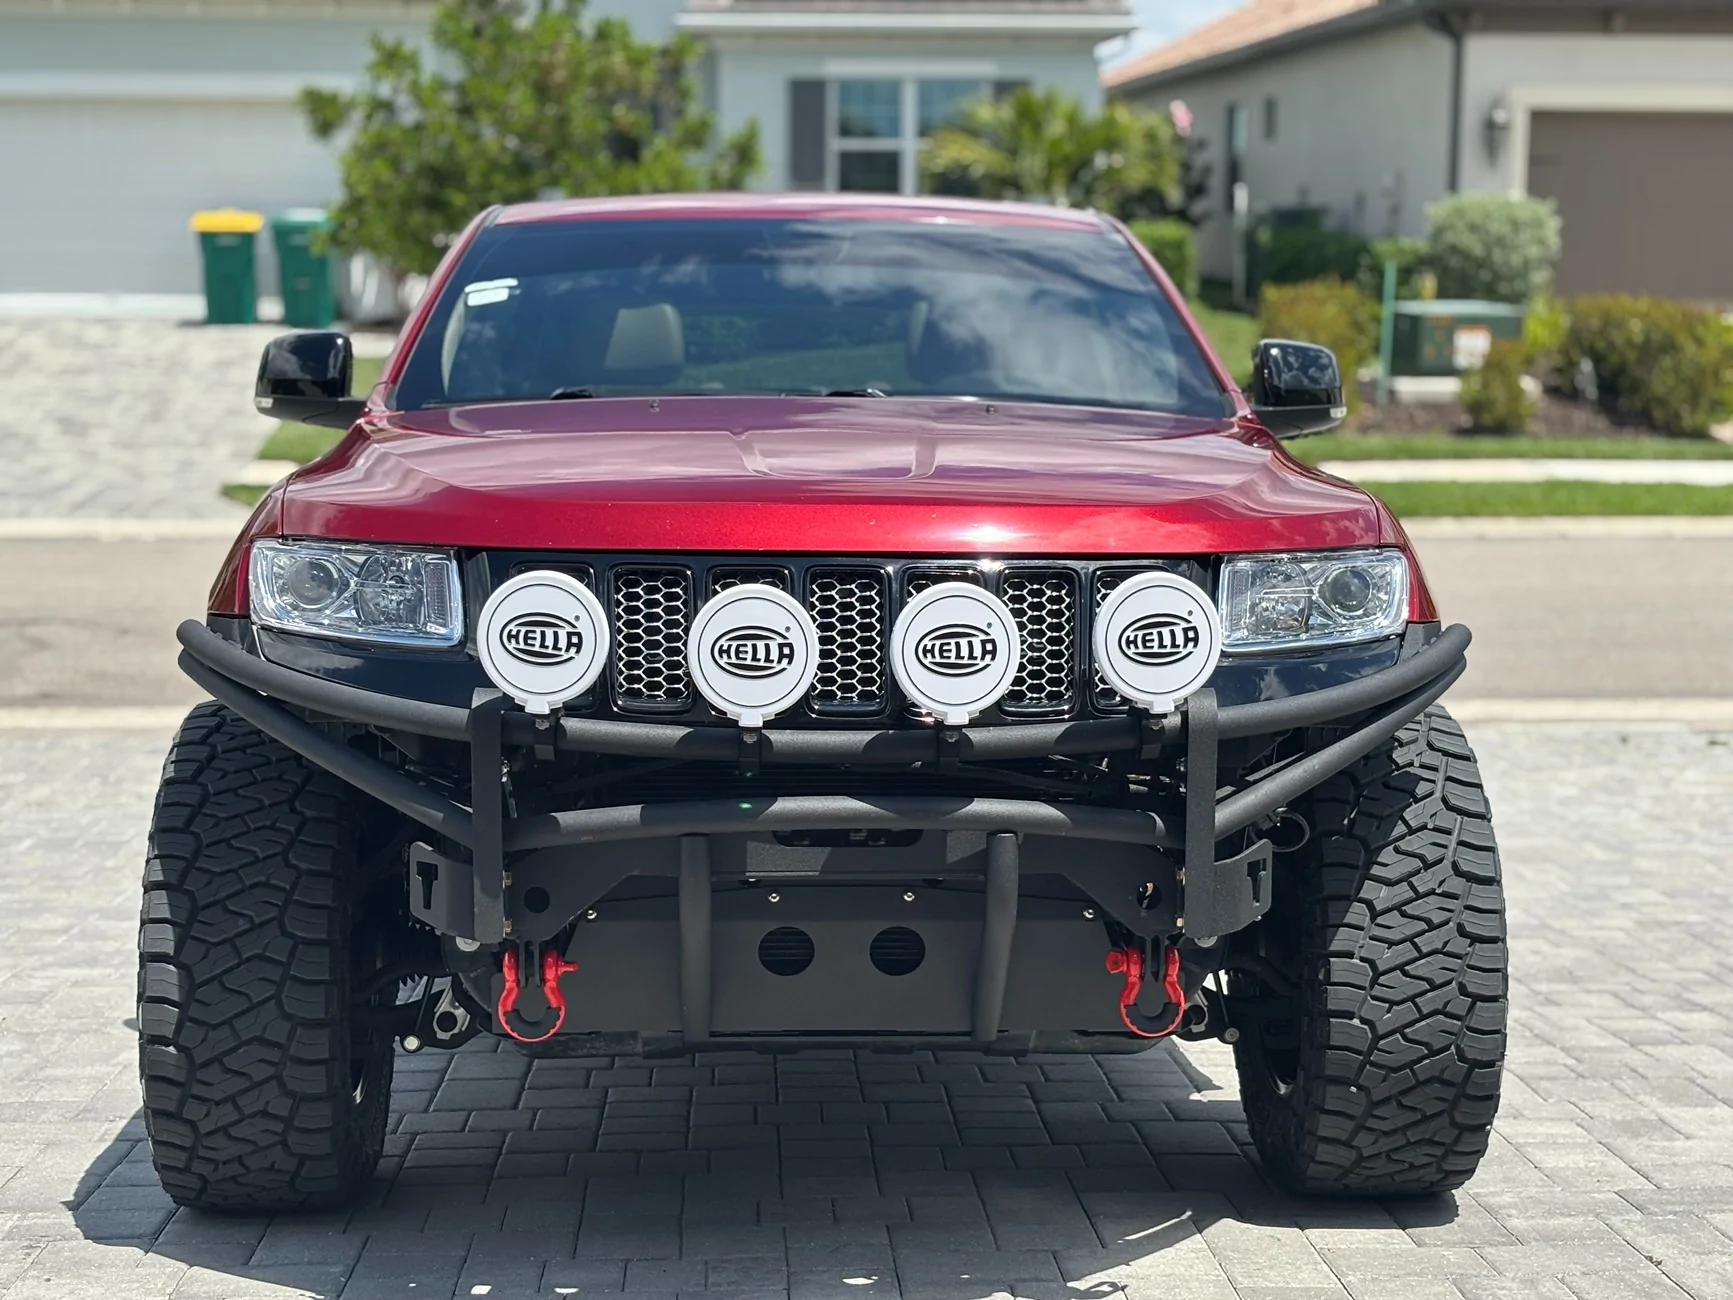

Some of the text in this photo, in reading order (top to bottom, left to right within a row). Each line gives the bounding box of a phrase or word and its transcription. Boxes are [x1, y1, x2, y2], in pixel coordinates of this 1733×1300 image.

[506, 629, 582, 654] HELLA
[922, 638, 997, 662] HELLA
[1126, 626, 1199, 650] HELLA
[719, 642, 794, 667] HELLA
